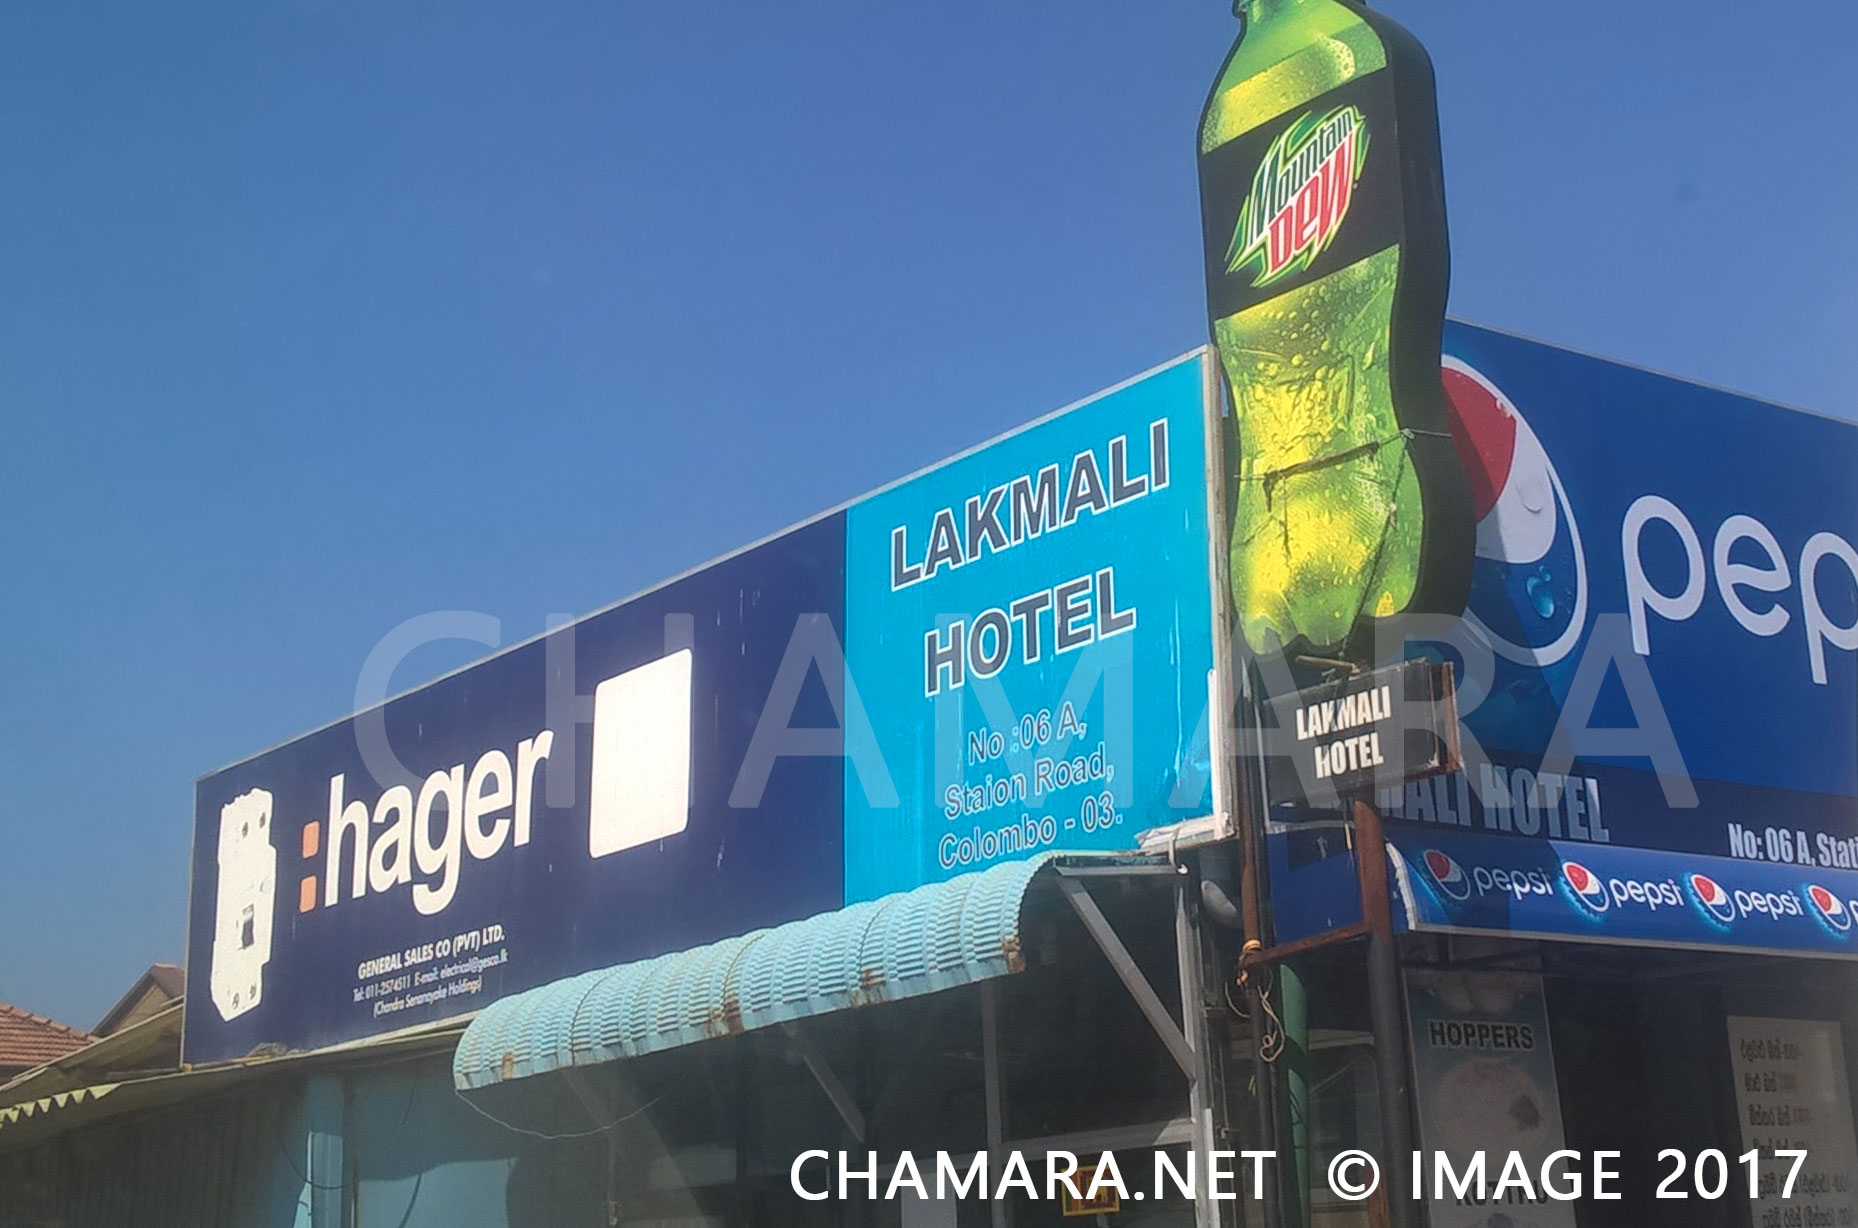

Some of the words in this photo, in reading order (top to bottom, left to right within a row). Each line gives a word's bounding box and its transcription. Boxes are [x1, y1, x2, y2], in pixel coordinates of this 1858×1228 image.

[891, 417, 1170, 592] LAKMALI
[924, 566, 1137, 698] HOTEL
[968, 727, 1004, 766] No
[1057, 701, 1087, 740] A,
[1296, 685, 1392, 741] LAKMALI
[945, 773, 1027, 820] Staion
[1035, 741, 1114, 796] Road,
[1314, 732, 1384, 779] HOTEL
[939, 814, 1057, 870] Colombo
[1081, 791, 1123, 833] 03.
[1479, 763, 1610, 842] HOTEL
[1728, 823, 1764, 860] No:
[1765, 827, 1794, 862] 06
[1473, 867, 1554, 900] pepsi
[1609, 878, 1685, 911] pepsi
[1734, 889, 1804, 920] pepsi
[358, 951, 402, 980] GENERAL
[404, 943, 434, 967] SALES
[435, 939, 450, 958] CO
[452, 930, 481, 957] (PVT)
[482, 924, 505, 945] LTD.
[1428, 1018, 1535, 1052] HOPPERS
